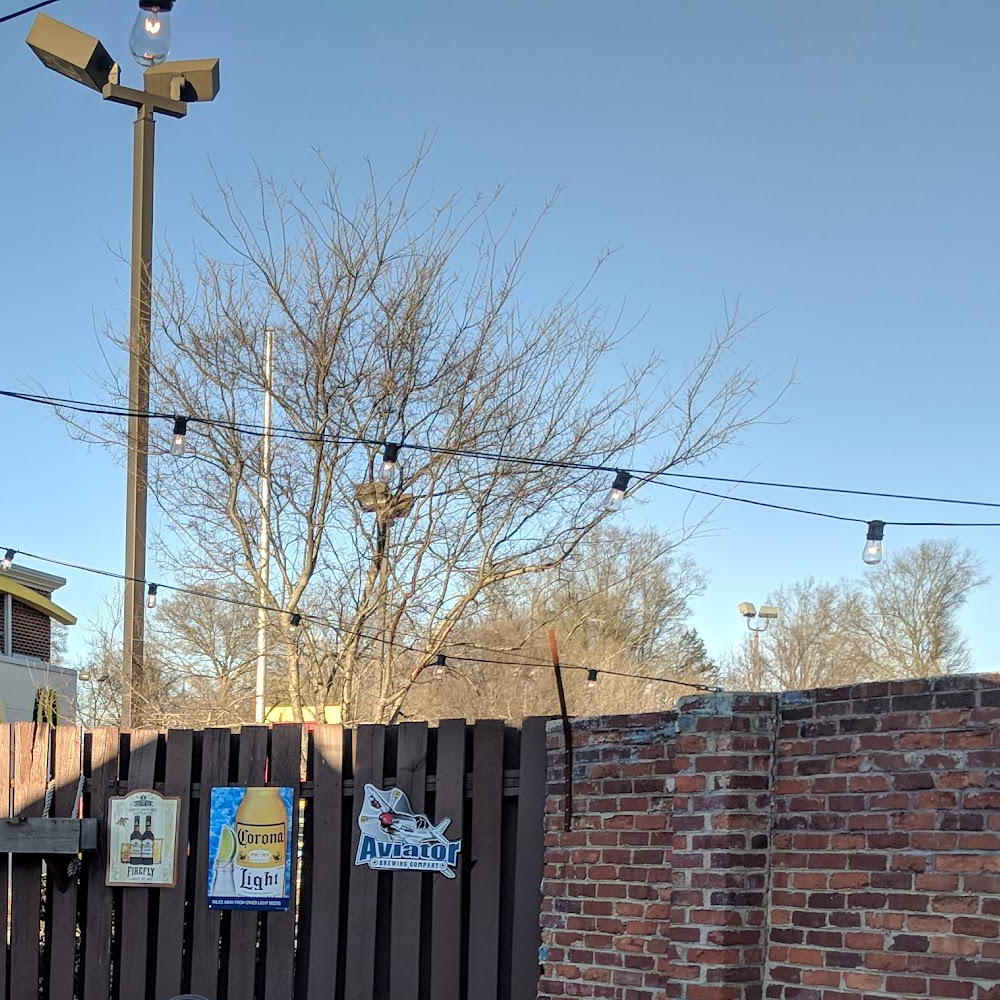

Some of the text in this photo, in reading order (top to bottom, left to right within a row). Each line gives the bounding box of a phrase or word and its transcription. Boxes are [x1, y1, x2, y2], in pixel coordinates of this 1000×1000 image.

[237, 828, 285, 846] Corona
[359, 835, 460, 864] Aviator
[127, 865, 156, 877] FIREFLY
[239, 867, 279, 891] Light
